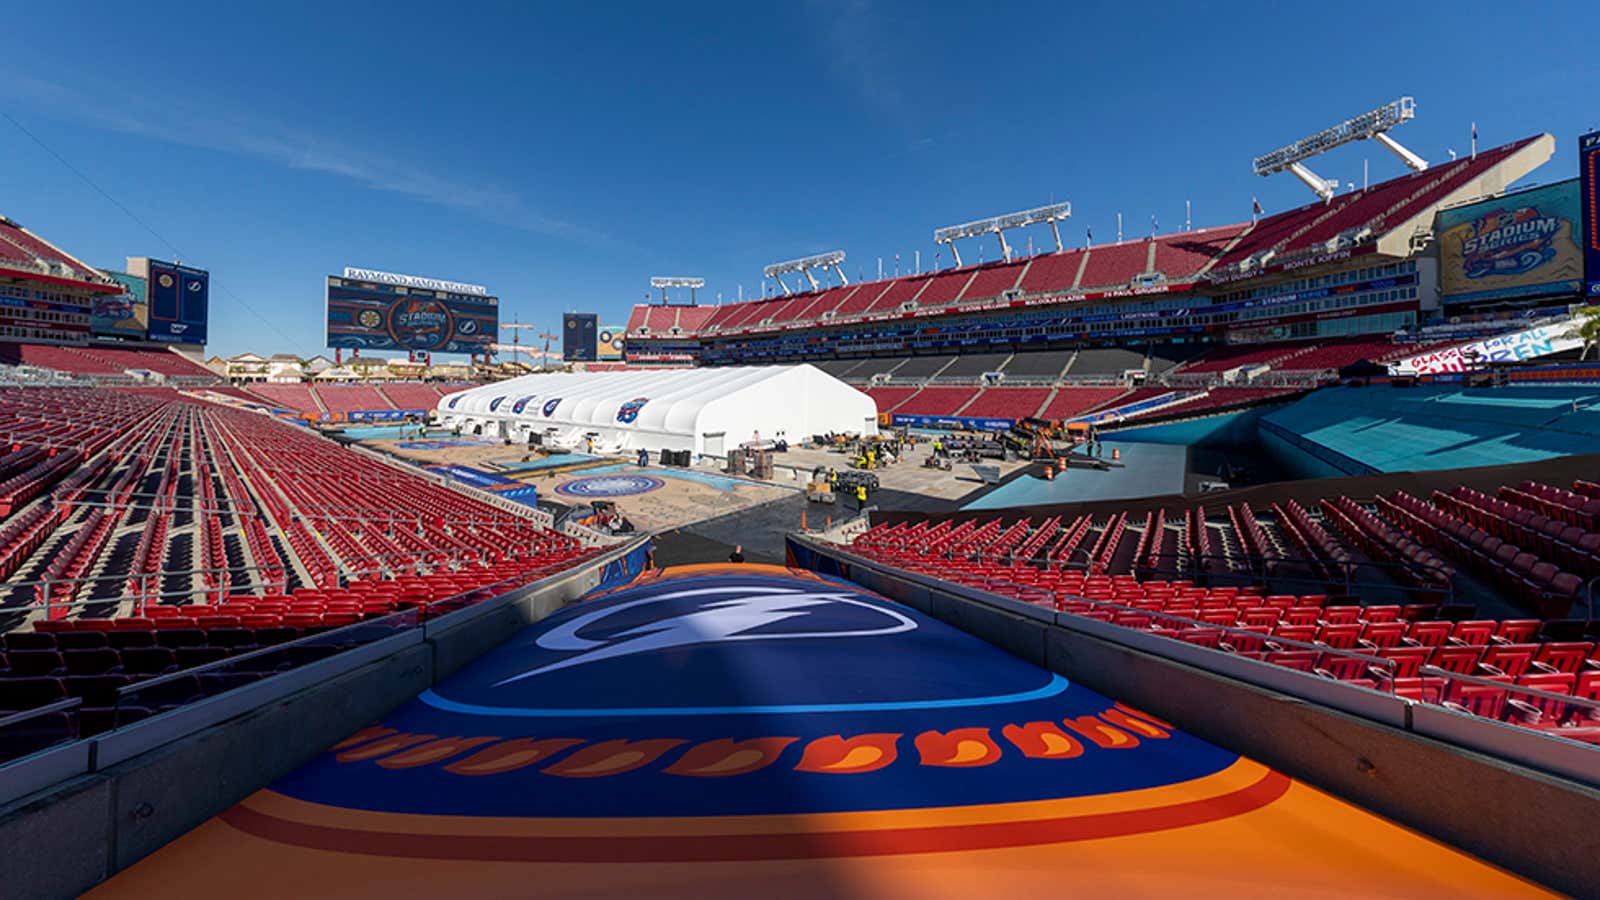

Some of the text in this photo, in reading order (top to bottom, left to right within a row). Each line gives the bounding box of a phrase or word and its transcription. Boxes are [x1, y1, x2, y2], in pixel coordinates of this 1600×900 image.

[1463, 217, 1556, 255] STADIUM
[1284, 255, 1316, 270] MONTE
[348, 269, 407, 285] RAYMOND
[407, 276, 443, 290] JAMES
[444, 281, 486, 296] STADIUM
[1113, 287, 1133, 297] PAUL
[1134, 284, 1169, 294] GRUBER
[1025, 293, 1086, 306] MALCOLM GLAZER
[1262, 293, 1297, 306] STADIUM
[400, 311, 447, 325] STADIUM
[1411, 328, 1547, 368] GLASSES FOR ALL
